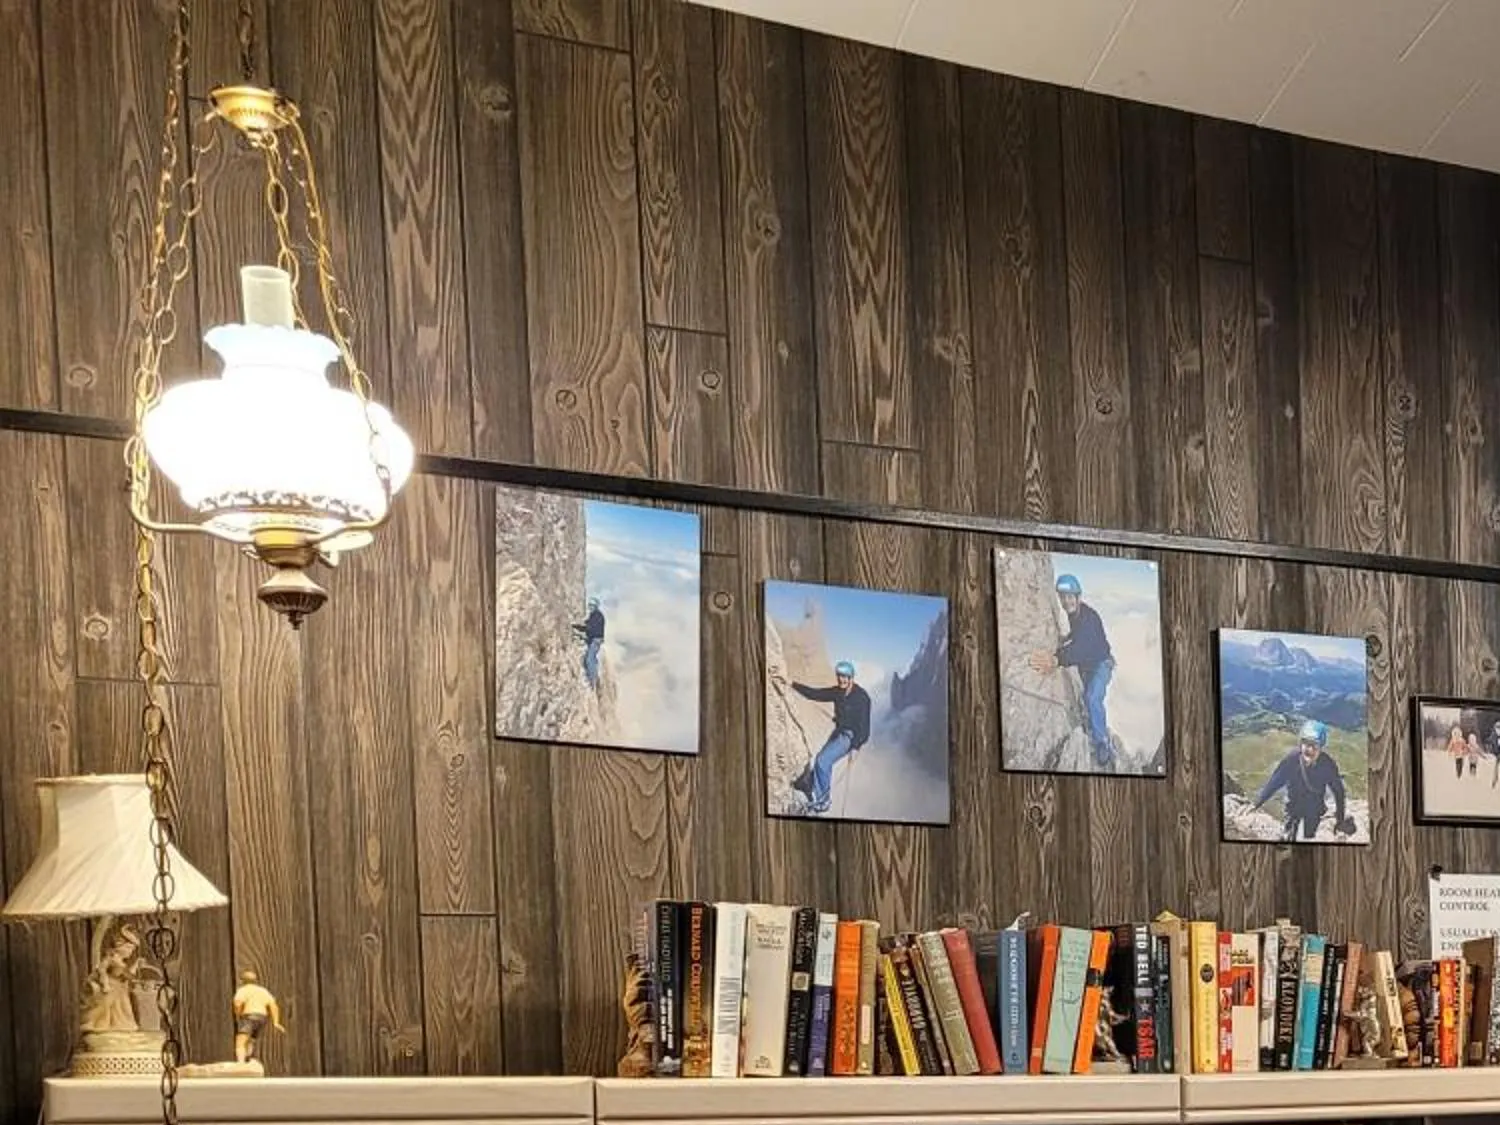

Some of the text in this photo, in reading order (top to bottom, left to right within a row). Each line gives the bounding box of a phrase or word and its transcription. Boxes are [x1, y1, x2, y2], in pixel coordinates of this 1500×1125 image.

[1439, 887, 1471, 898] ROOM
[1439, 901, 1490, 911] CONTROL
[691, 907, 703, 959] BERNARD
[1135, 926, 1154, 1060] TED BELL TSAR
[1279, 979, 1295, 1043] KLONDIKE
